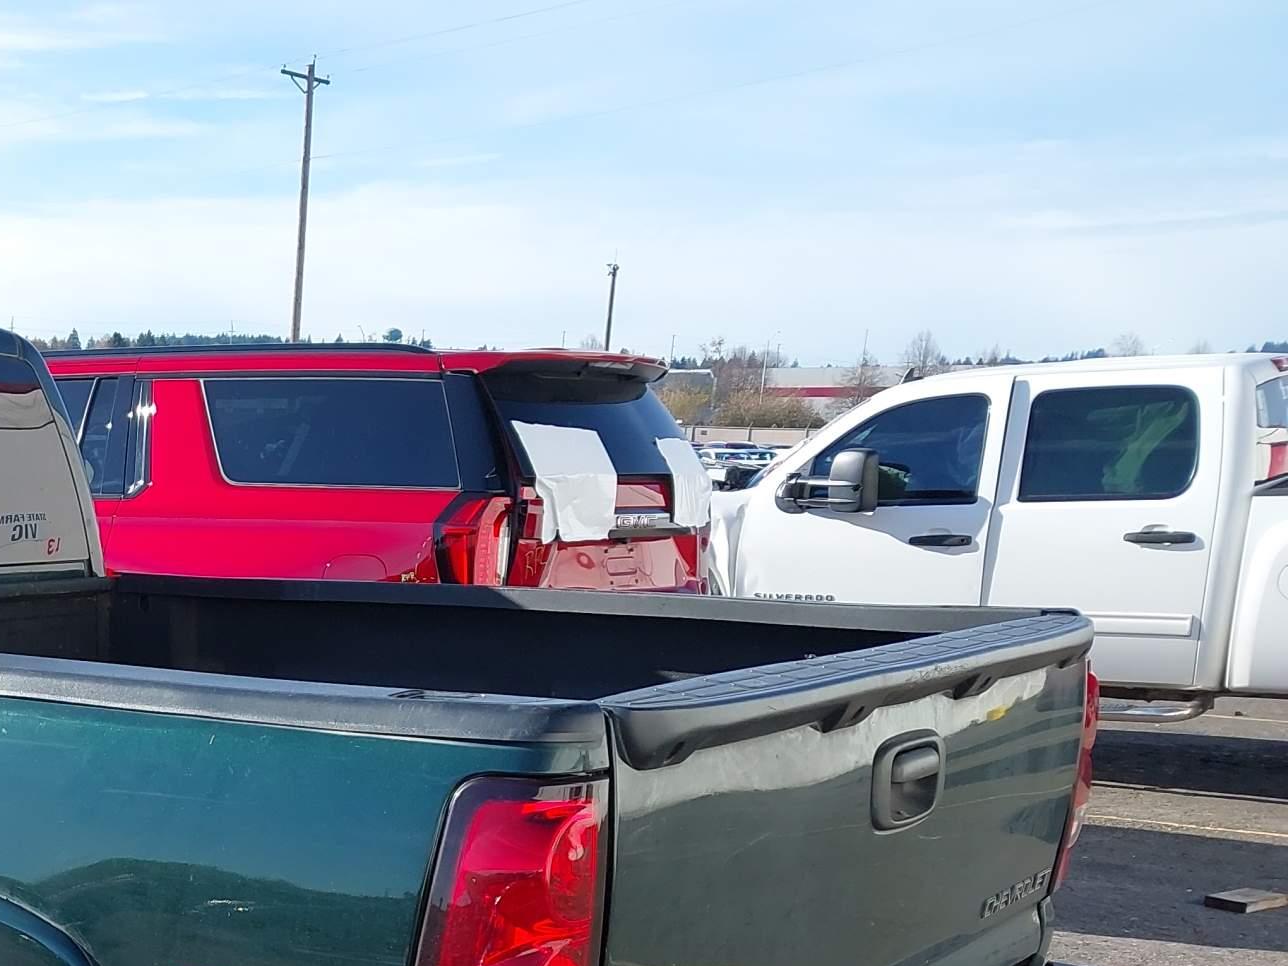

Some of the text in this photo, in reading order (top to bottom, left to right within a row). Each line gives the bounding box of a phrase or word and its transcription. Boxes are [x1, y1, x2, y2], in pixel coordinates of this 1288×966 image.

[616, 514, 657, 528] GMC
[753, 592, 836, 602] SILVERADO
[980, 867, 1053, 919] CHEVROLET
